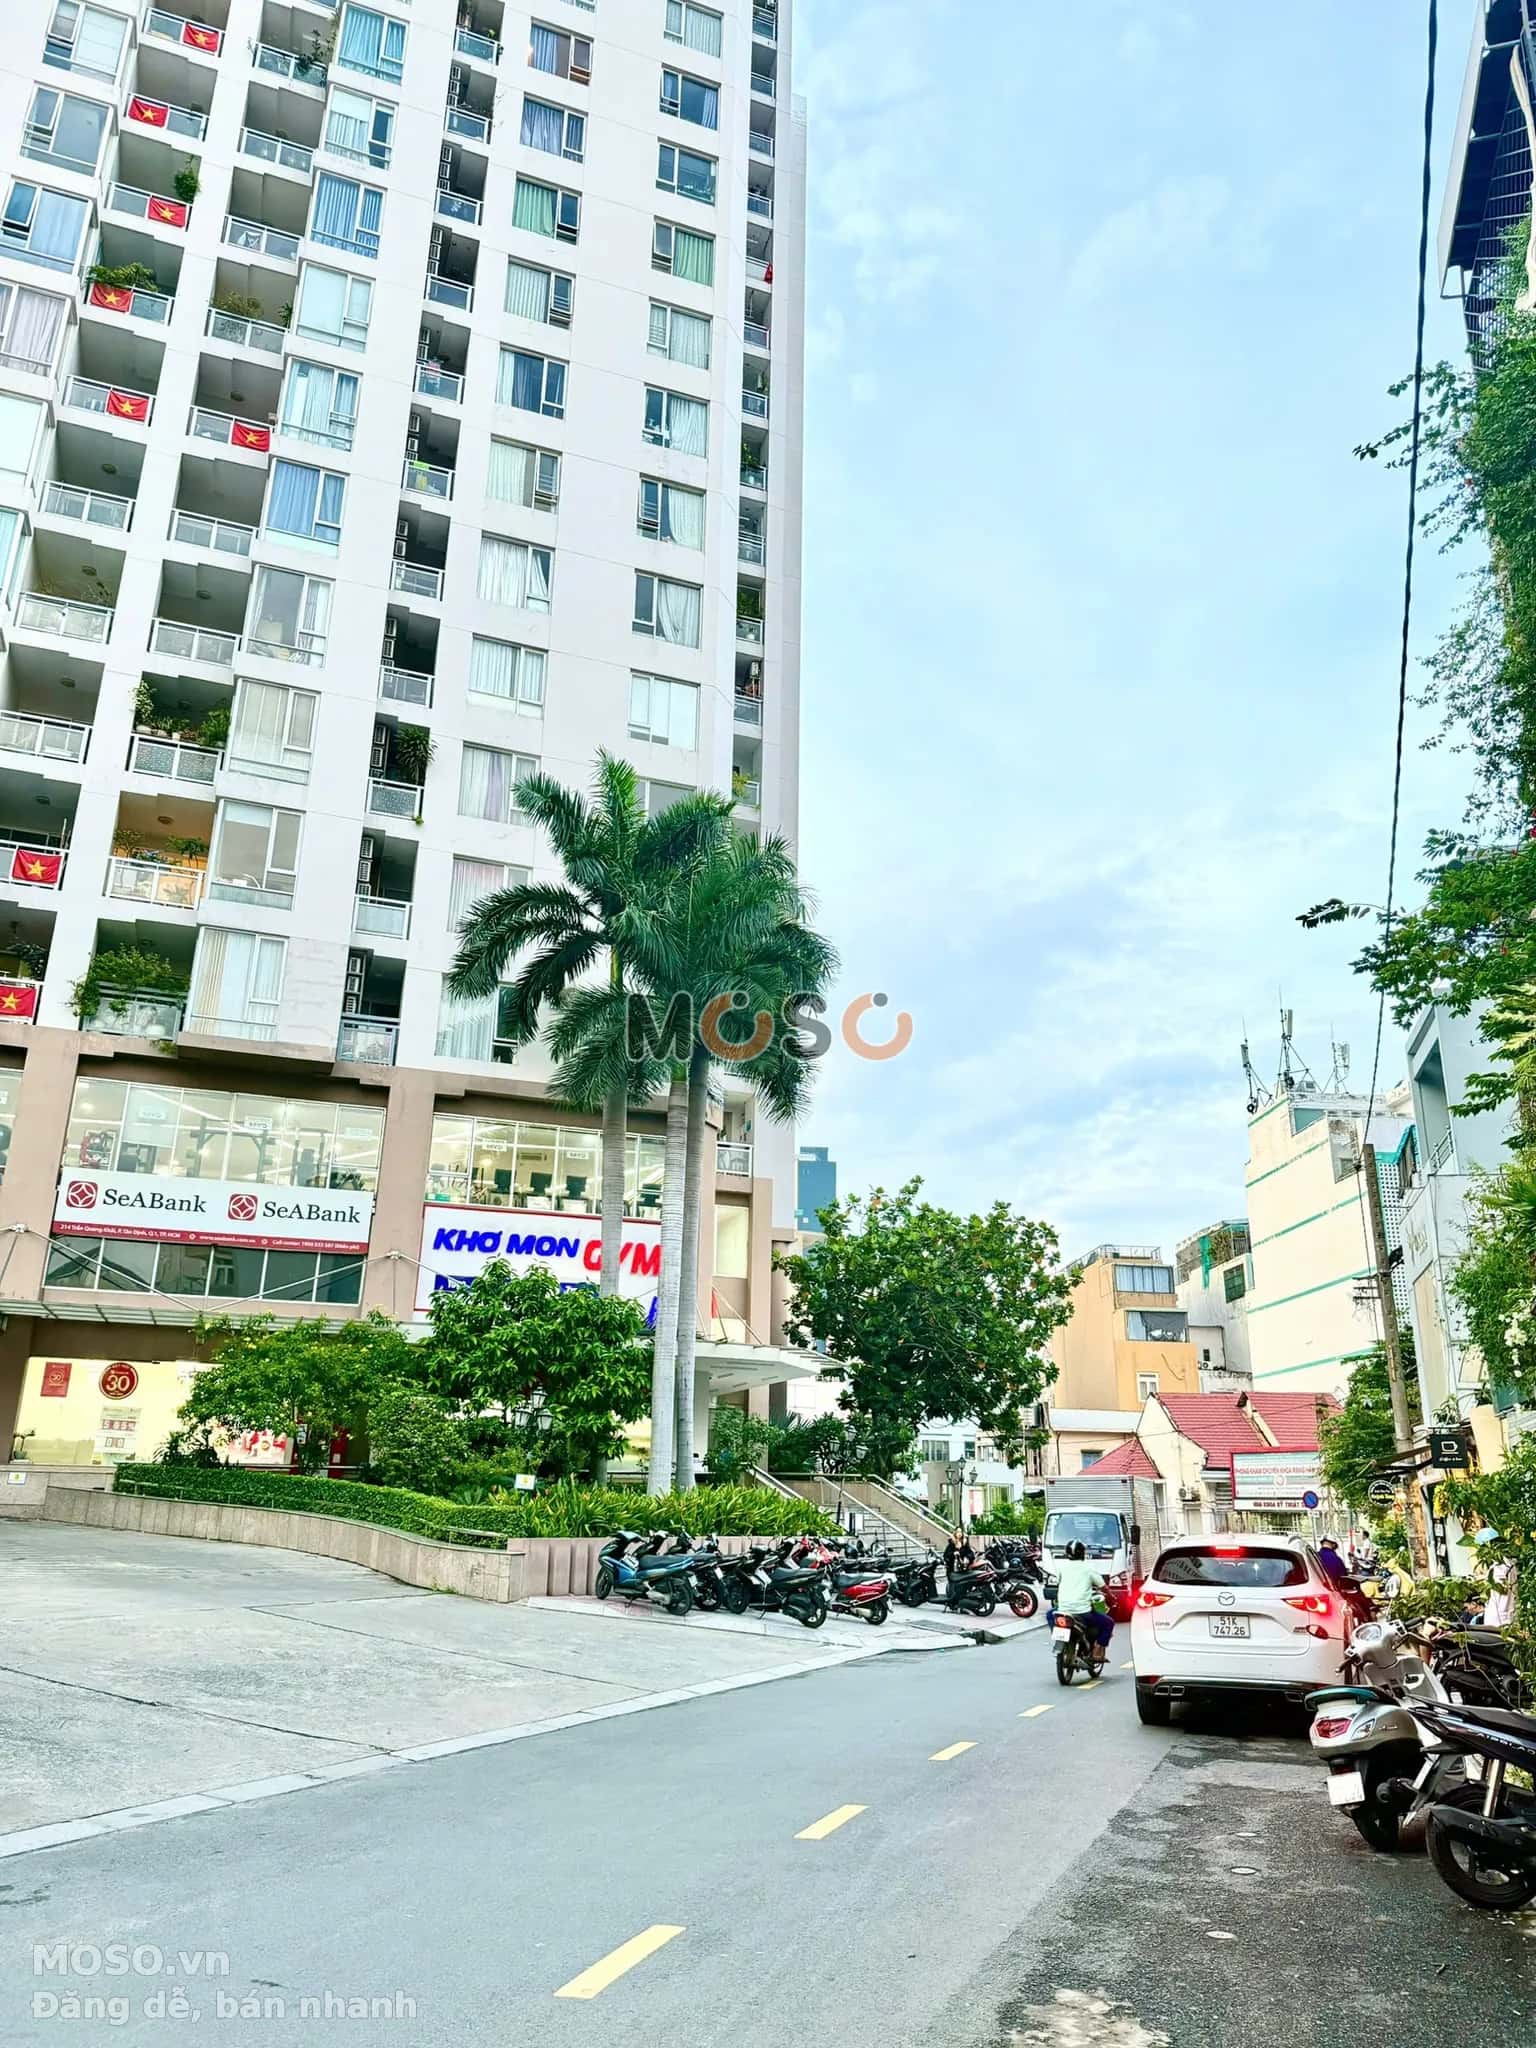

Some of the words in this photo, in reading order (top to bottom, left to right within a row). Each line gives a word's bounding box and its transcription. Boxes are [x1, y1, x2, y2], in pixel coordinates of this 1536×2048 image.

[102, 1188, 207, 1213] SeABank
[262, 1202, 361, 1224] SeABank
[432, 1227, 503, 1253] KHƠ
[506, 1233, 580, 1258] MON
[583, 1239, 662, 1276] GM
[105, 1375, 130, 1392] 30
[1219, 1616, 1238, 1626] 51K
